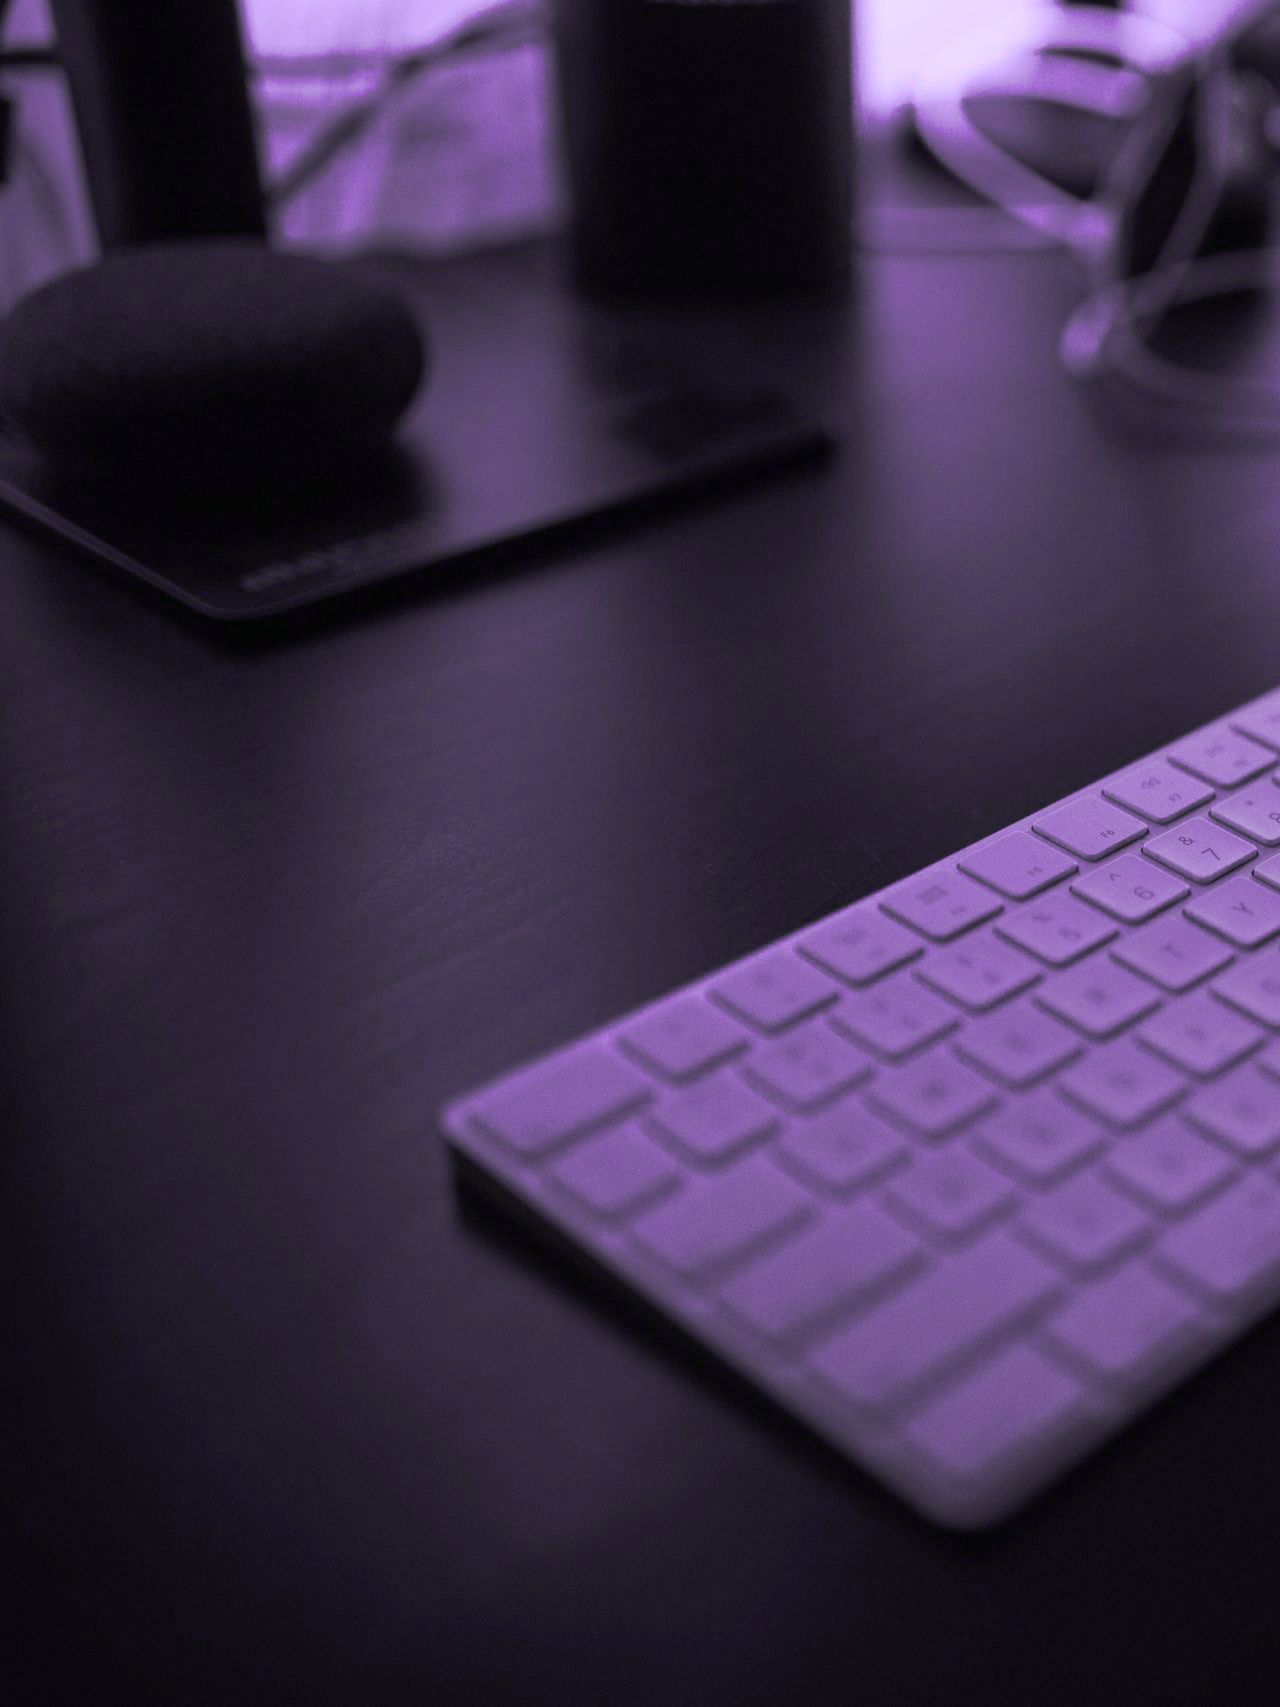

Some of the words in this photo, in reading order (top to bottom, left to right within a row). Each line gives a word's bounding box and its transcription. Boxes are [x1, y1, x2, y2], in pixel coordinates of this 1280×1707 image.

[1100, 828, 1115, 838] F6
[1178, 836, 1196, 846] &
[1201, 848, 1220, 860] 7
[1134, 886, 1154, 900] 6
[1231, 902, 1254, 916] Y
